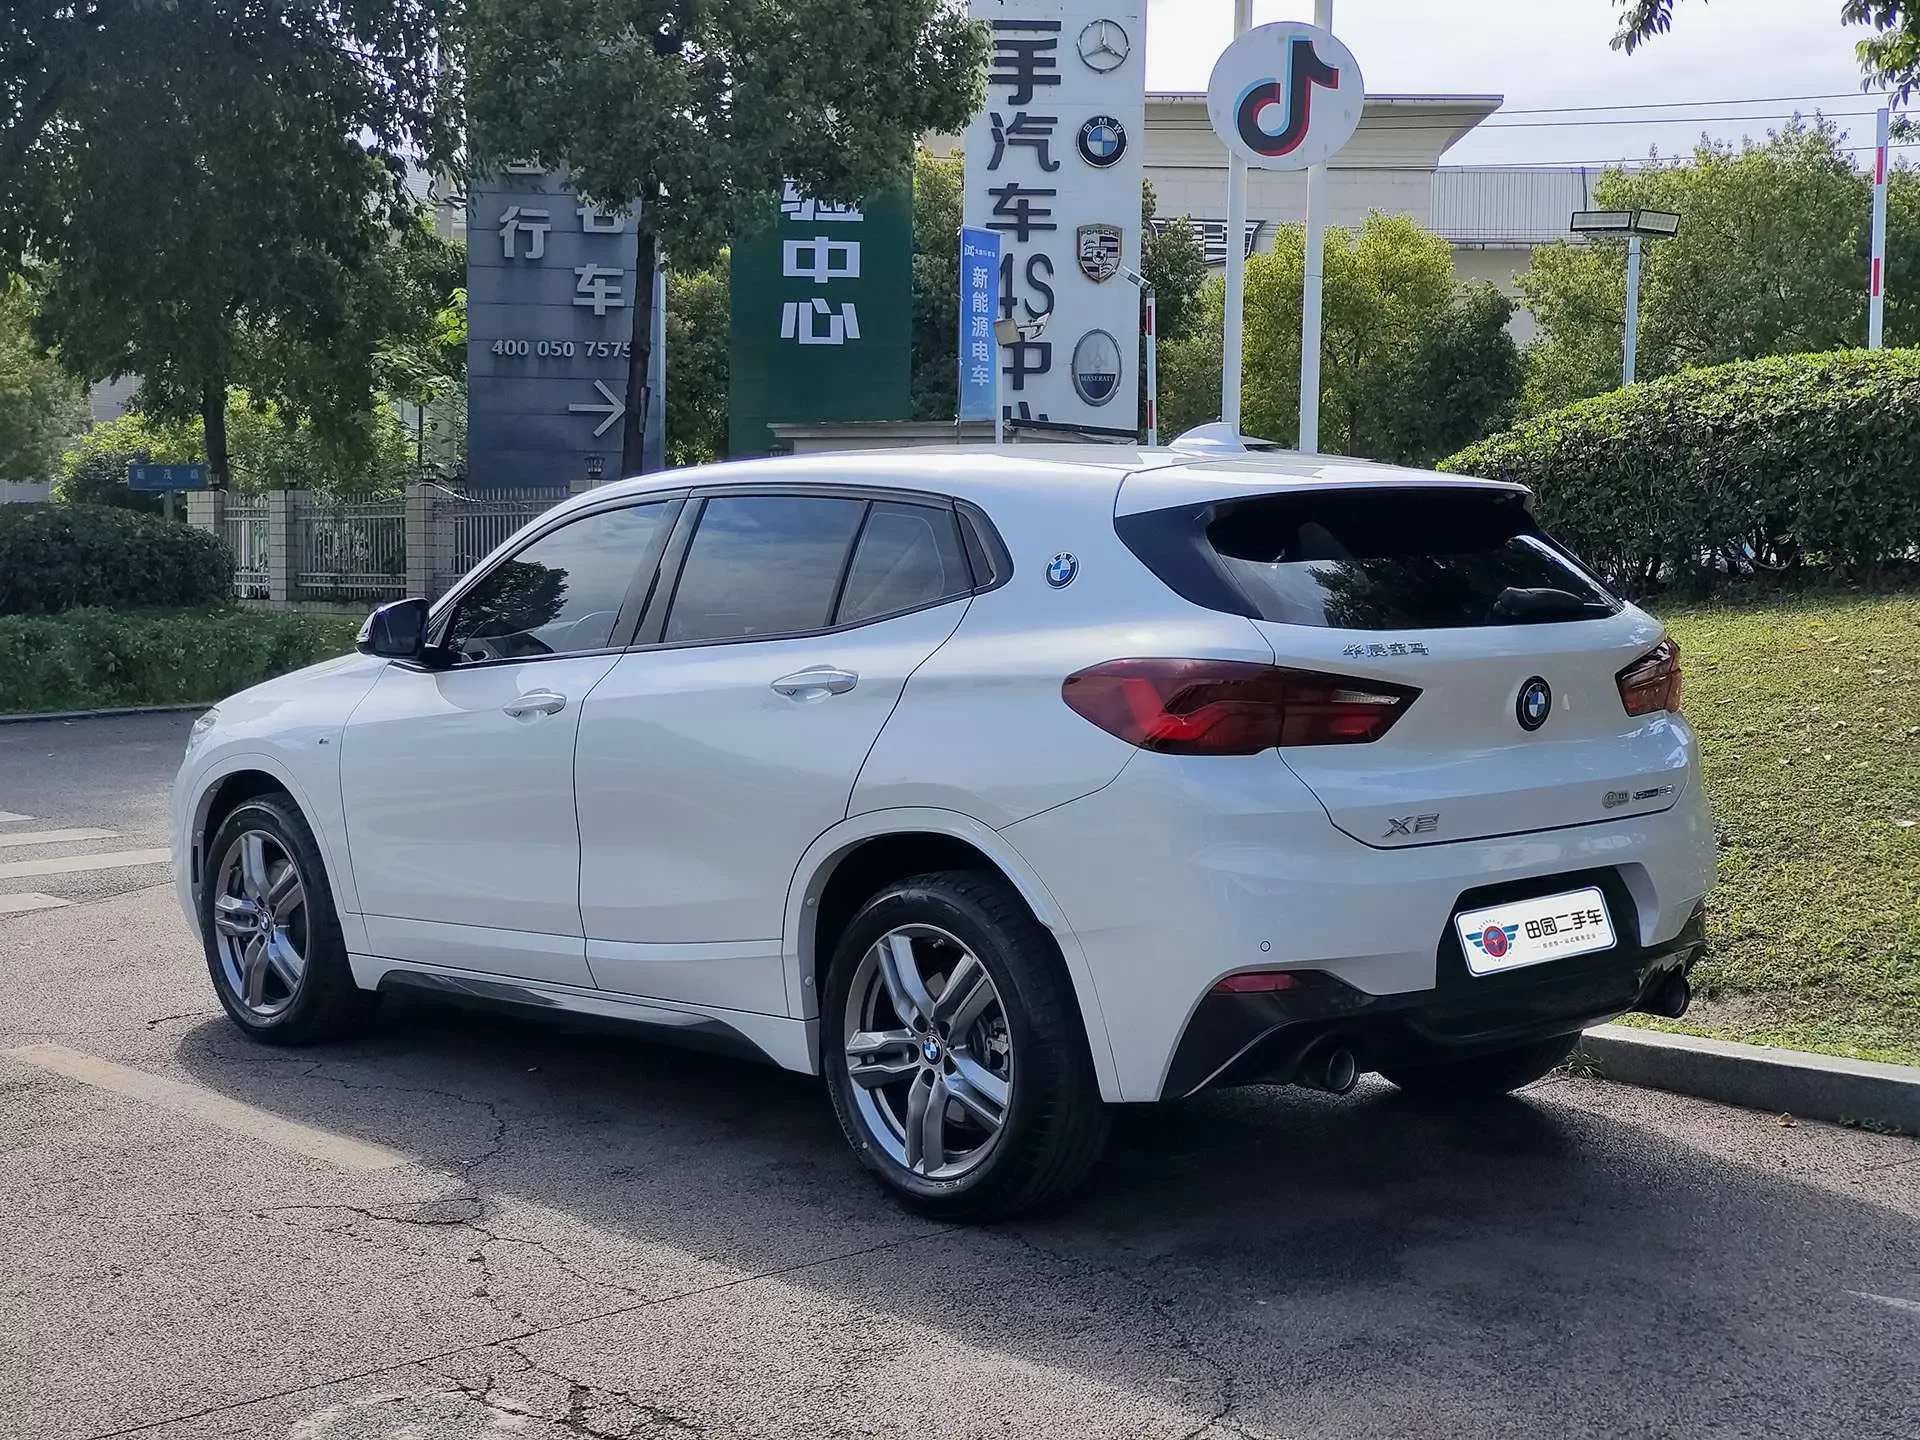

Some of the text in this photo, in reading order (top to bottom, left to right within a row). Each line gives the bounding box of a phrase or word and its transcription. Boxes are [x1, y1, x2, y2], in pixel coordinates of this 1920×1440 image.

[1083, 117, 1124, 134] BMW
[970, 265, 990, 387] 新能源电车
[491, 340, 632, 359] 400 050 7575
[1342, 640, 1430, 659] 华辰宝马
[1383, 812, 1440, 838] X2
[1525, 908, 1604, 940] 田园二手车
